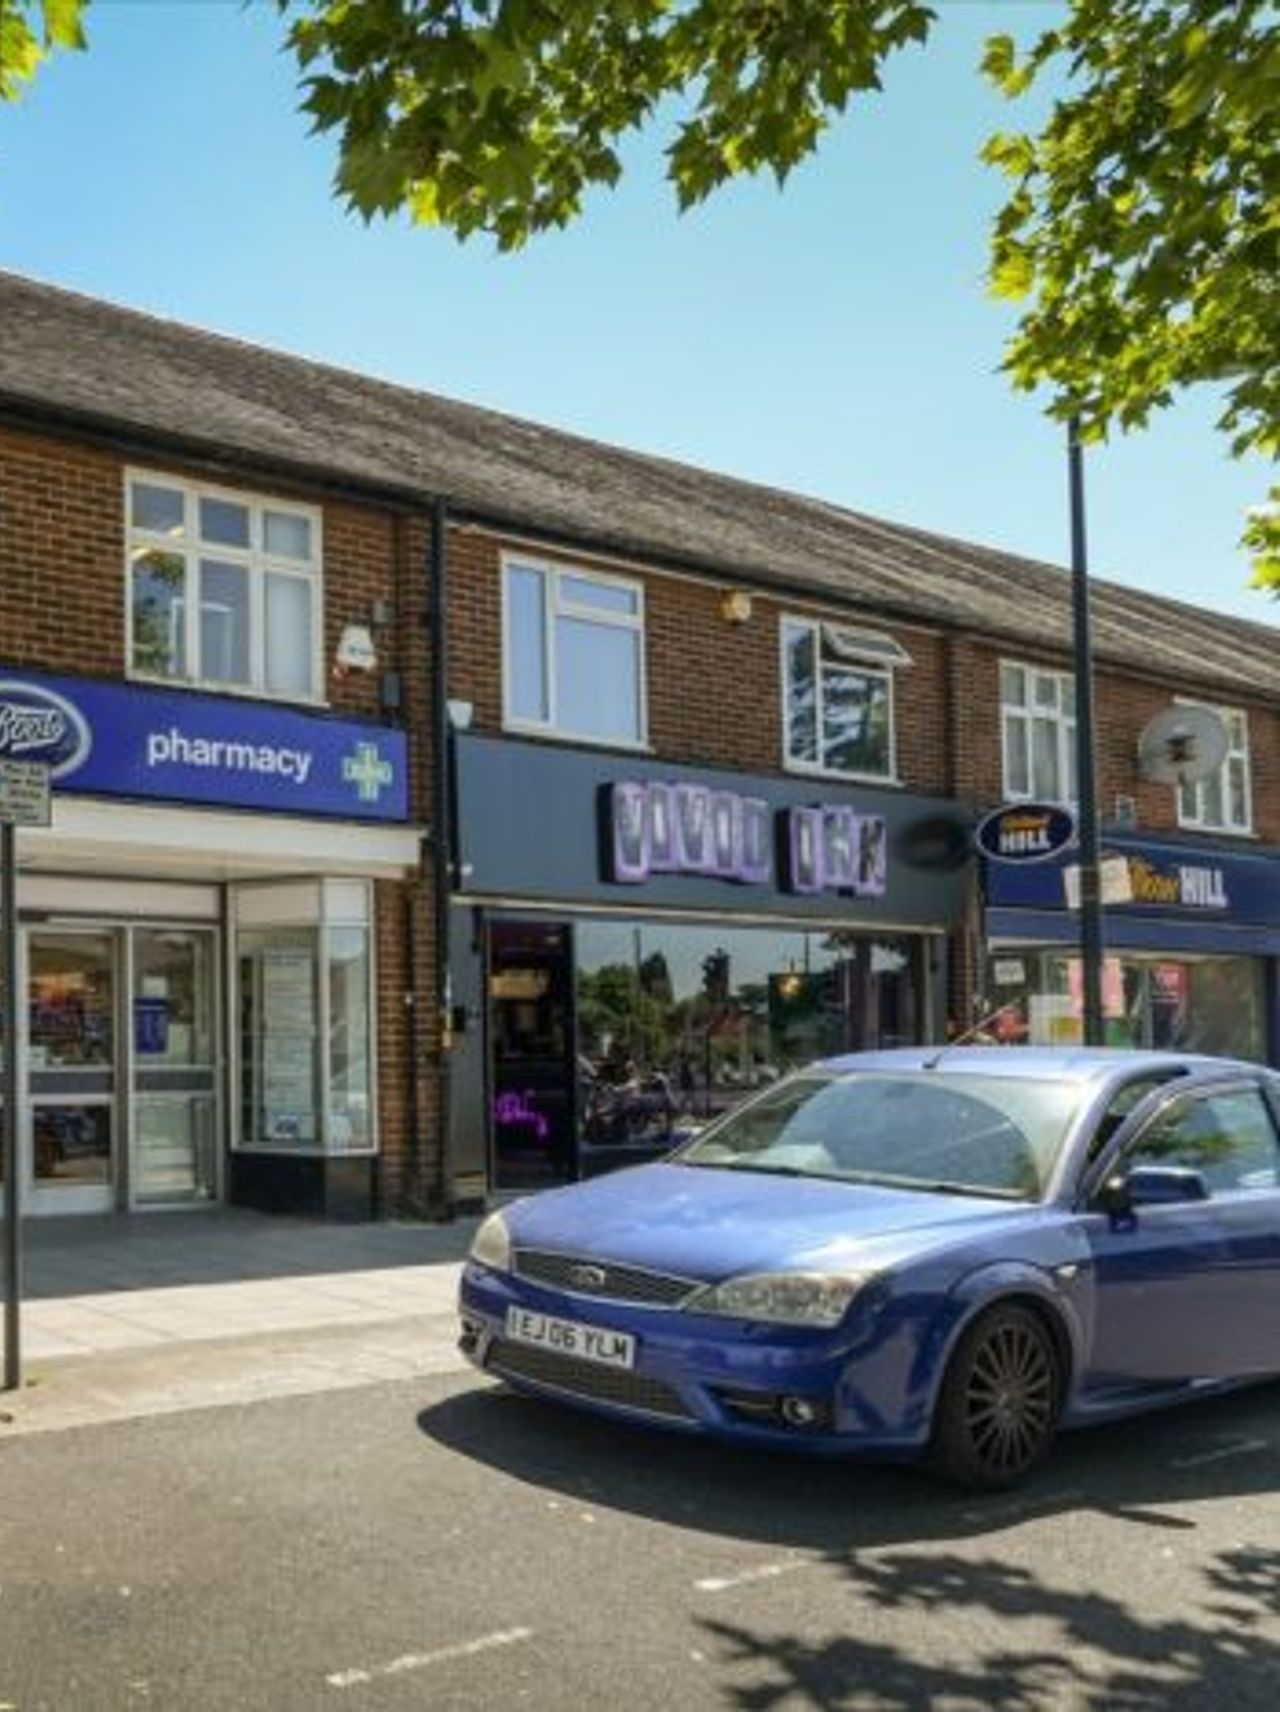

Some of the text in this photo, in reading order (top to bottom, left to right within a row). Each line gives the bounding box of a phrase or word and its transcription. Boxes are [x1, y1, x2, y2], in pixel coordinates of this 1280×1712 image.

[147, 728, 312, 784] pharmacy
[1000, 829, 1052, 854] HILL
[1180, 865, 1229, 907] HILL
[521, 1311, 627, 1363] EJ06 YLM
